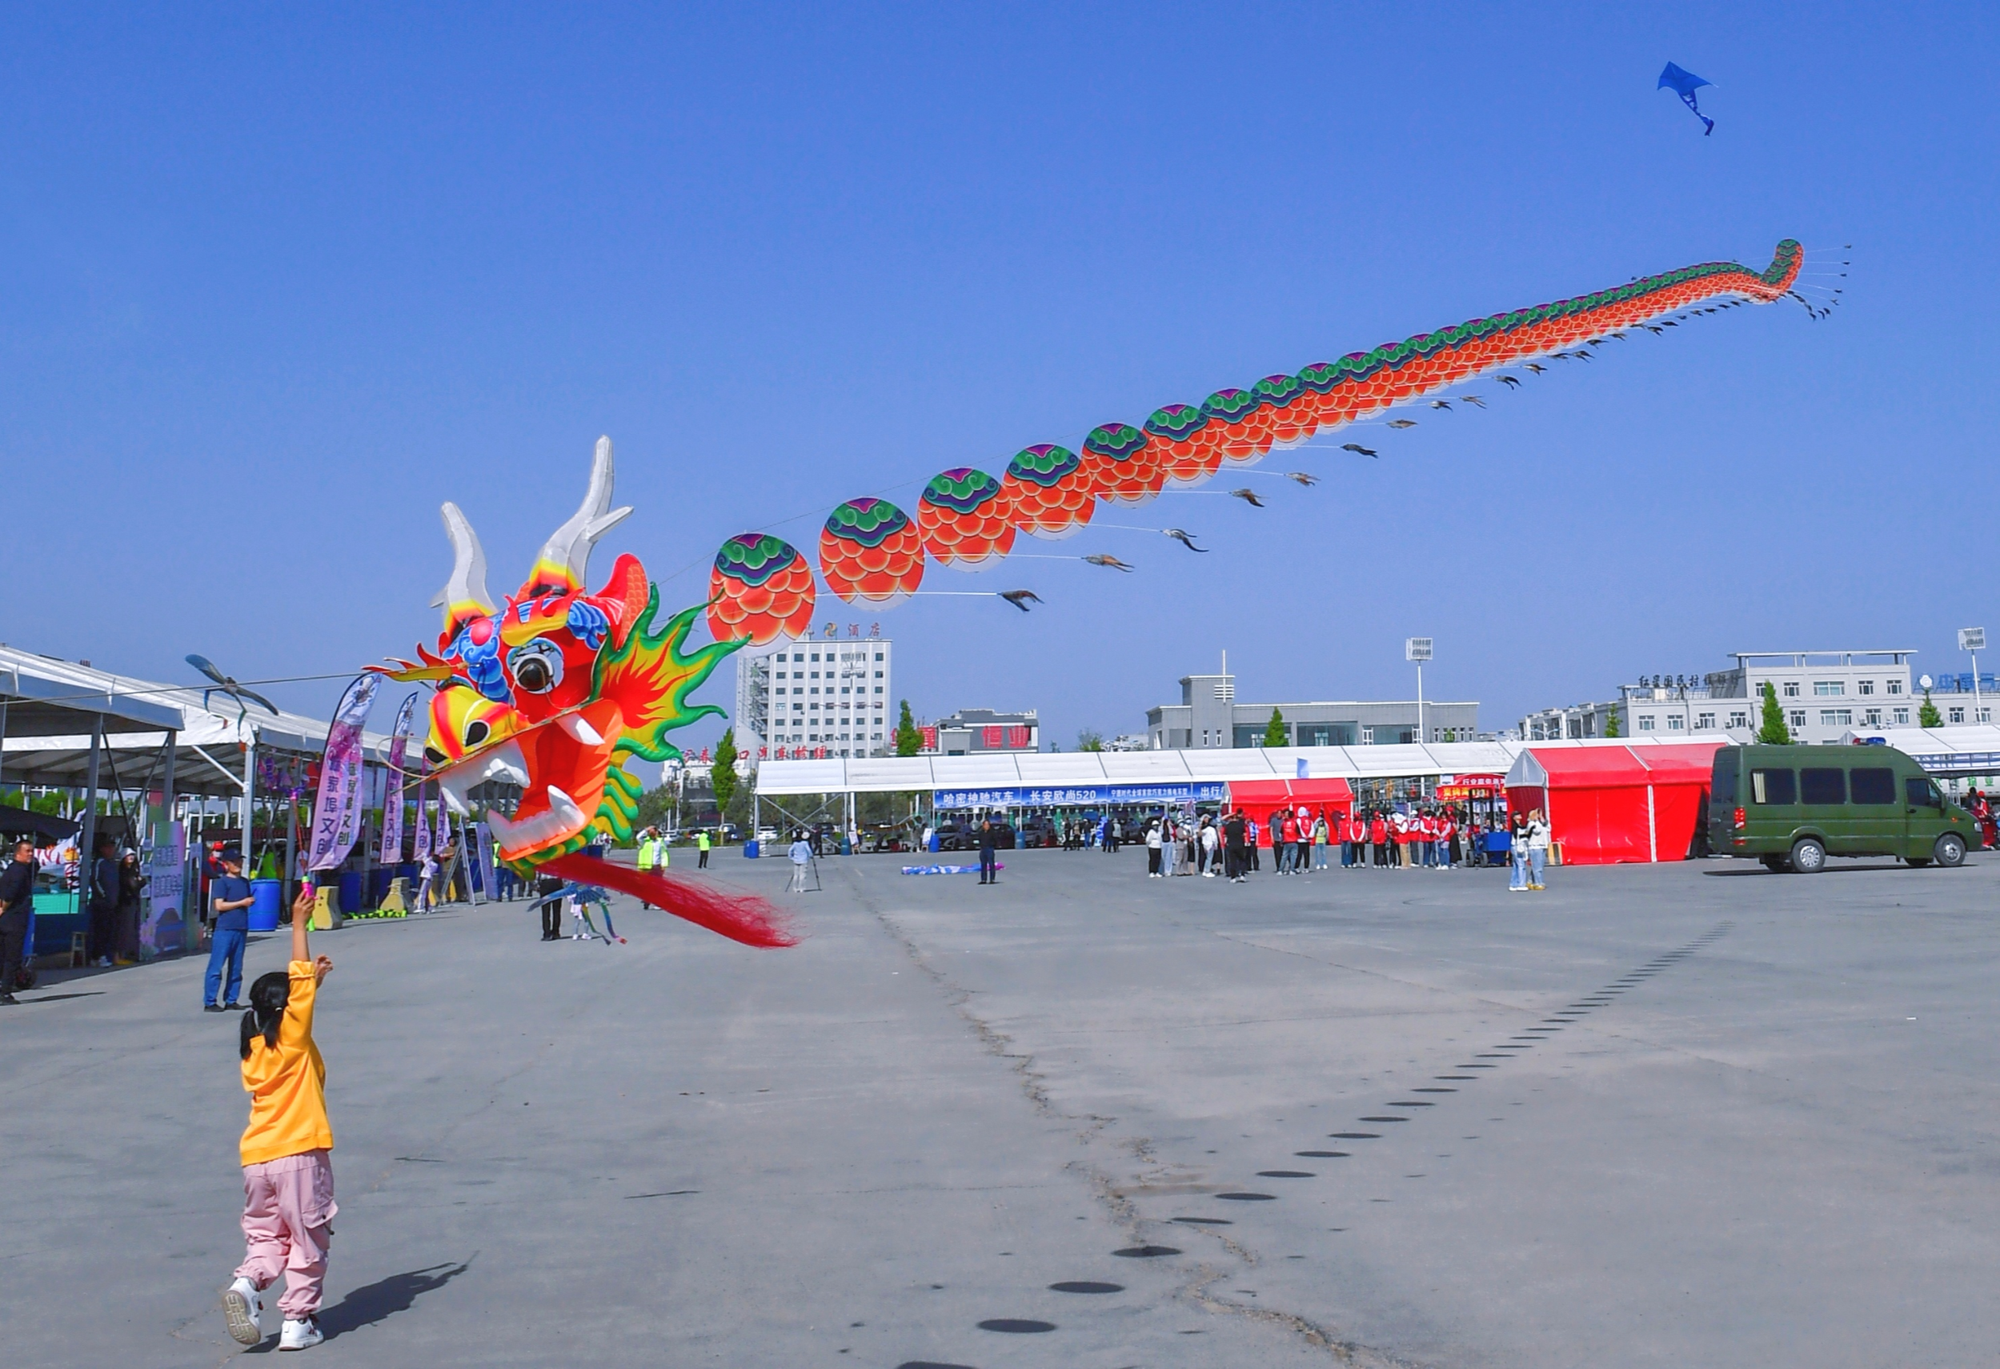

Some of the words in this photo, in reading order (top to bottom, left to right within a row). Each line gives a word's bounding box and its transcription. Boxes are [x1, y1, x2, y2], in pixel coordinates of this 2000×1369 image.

[943, 790, 1015, 805] 哈密神驰汽车
[1029, 789, 1097, 802] 长安欧尚520
[1200, 785, 1224, 797] 出行
